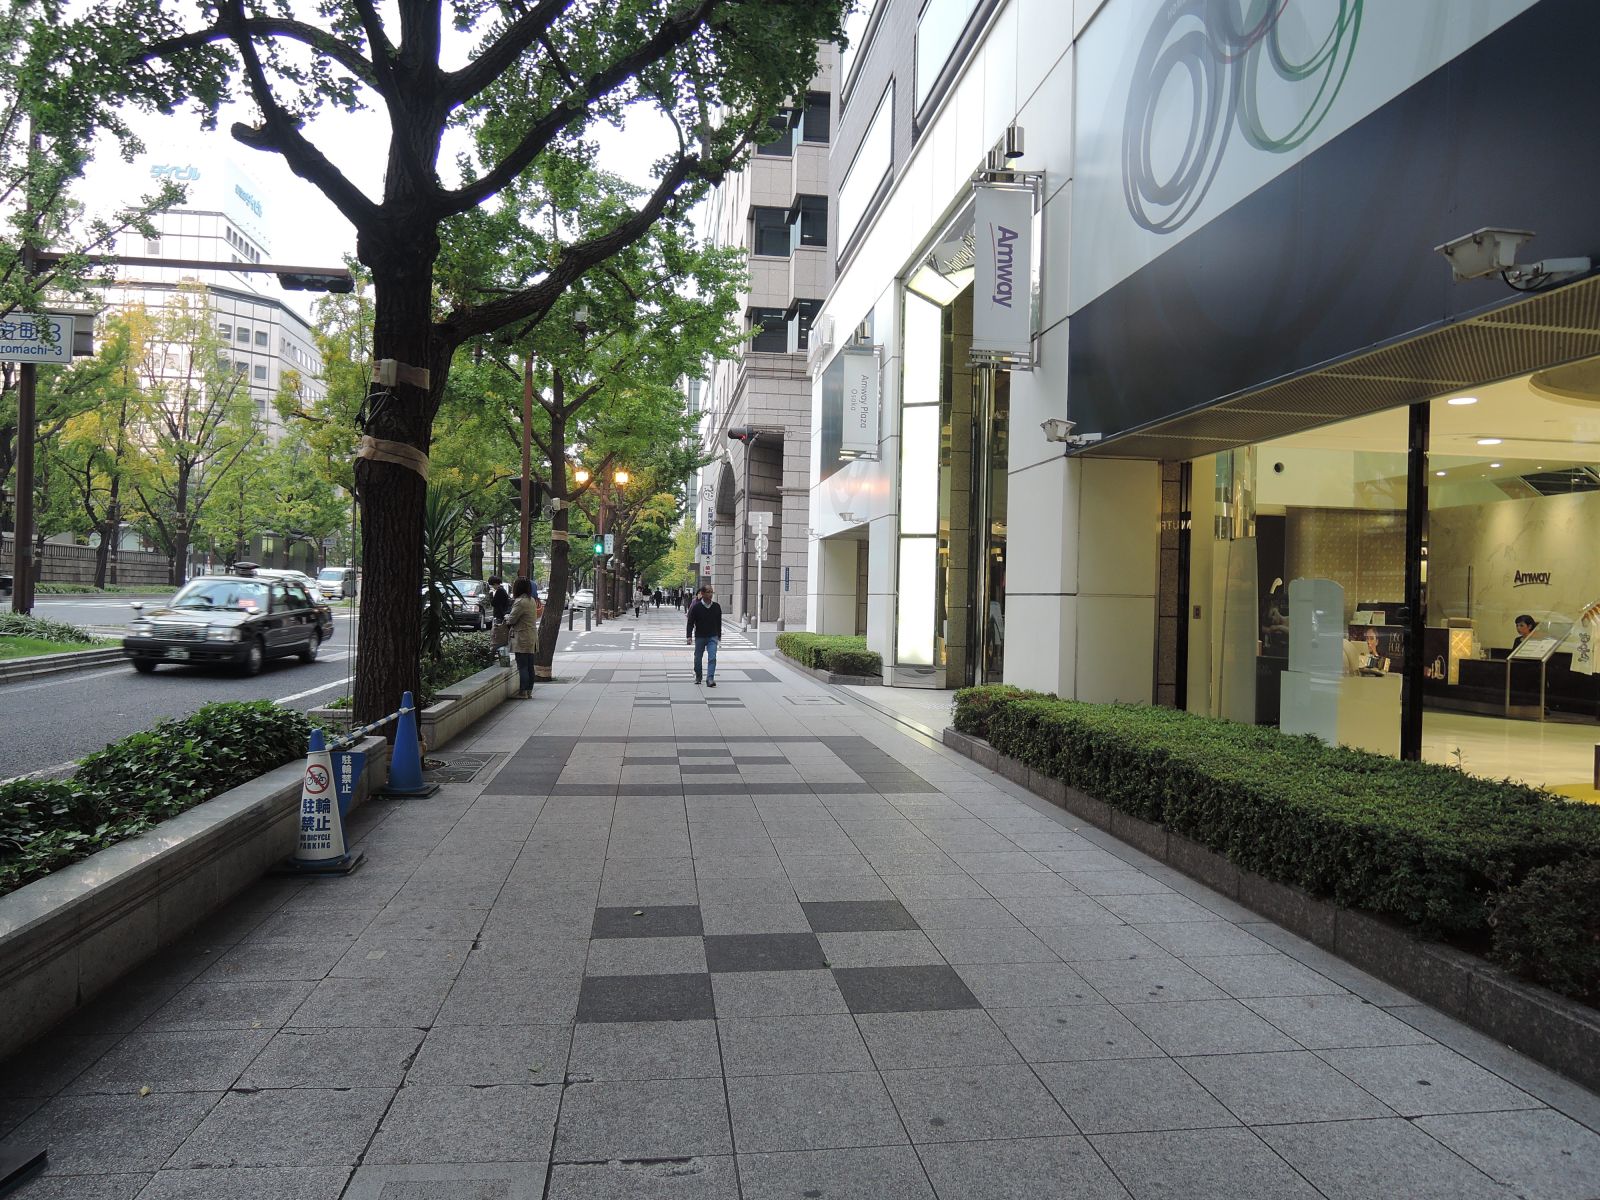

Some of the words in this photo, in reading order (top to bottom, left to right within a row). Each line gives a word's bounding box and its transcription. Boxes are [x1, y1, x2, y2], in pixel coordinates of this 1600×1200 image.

[992, 226, 1018, 308] Amway
[859, 374, 869, 404] Amway
[860, 407, 869, 429] Plaza
[1514, 570, 1551, 585] Amway
[342, 755, 352, 793] 駐輪禁止
[302, 798, 331, 814] 駐輪
[301, 816, 331, 832] 禁止
